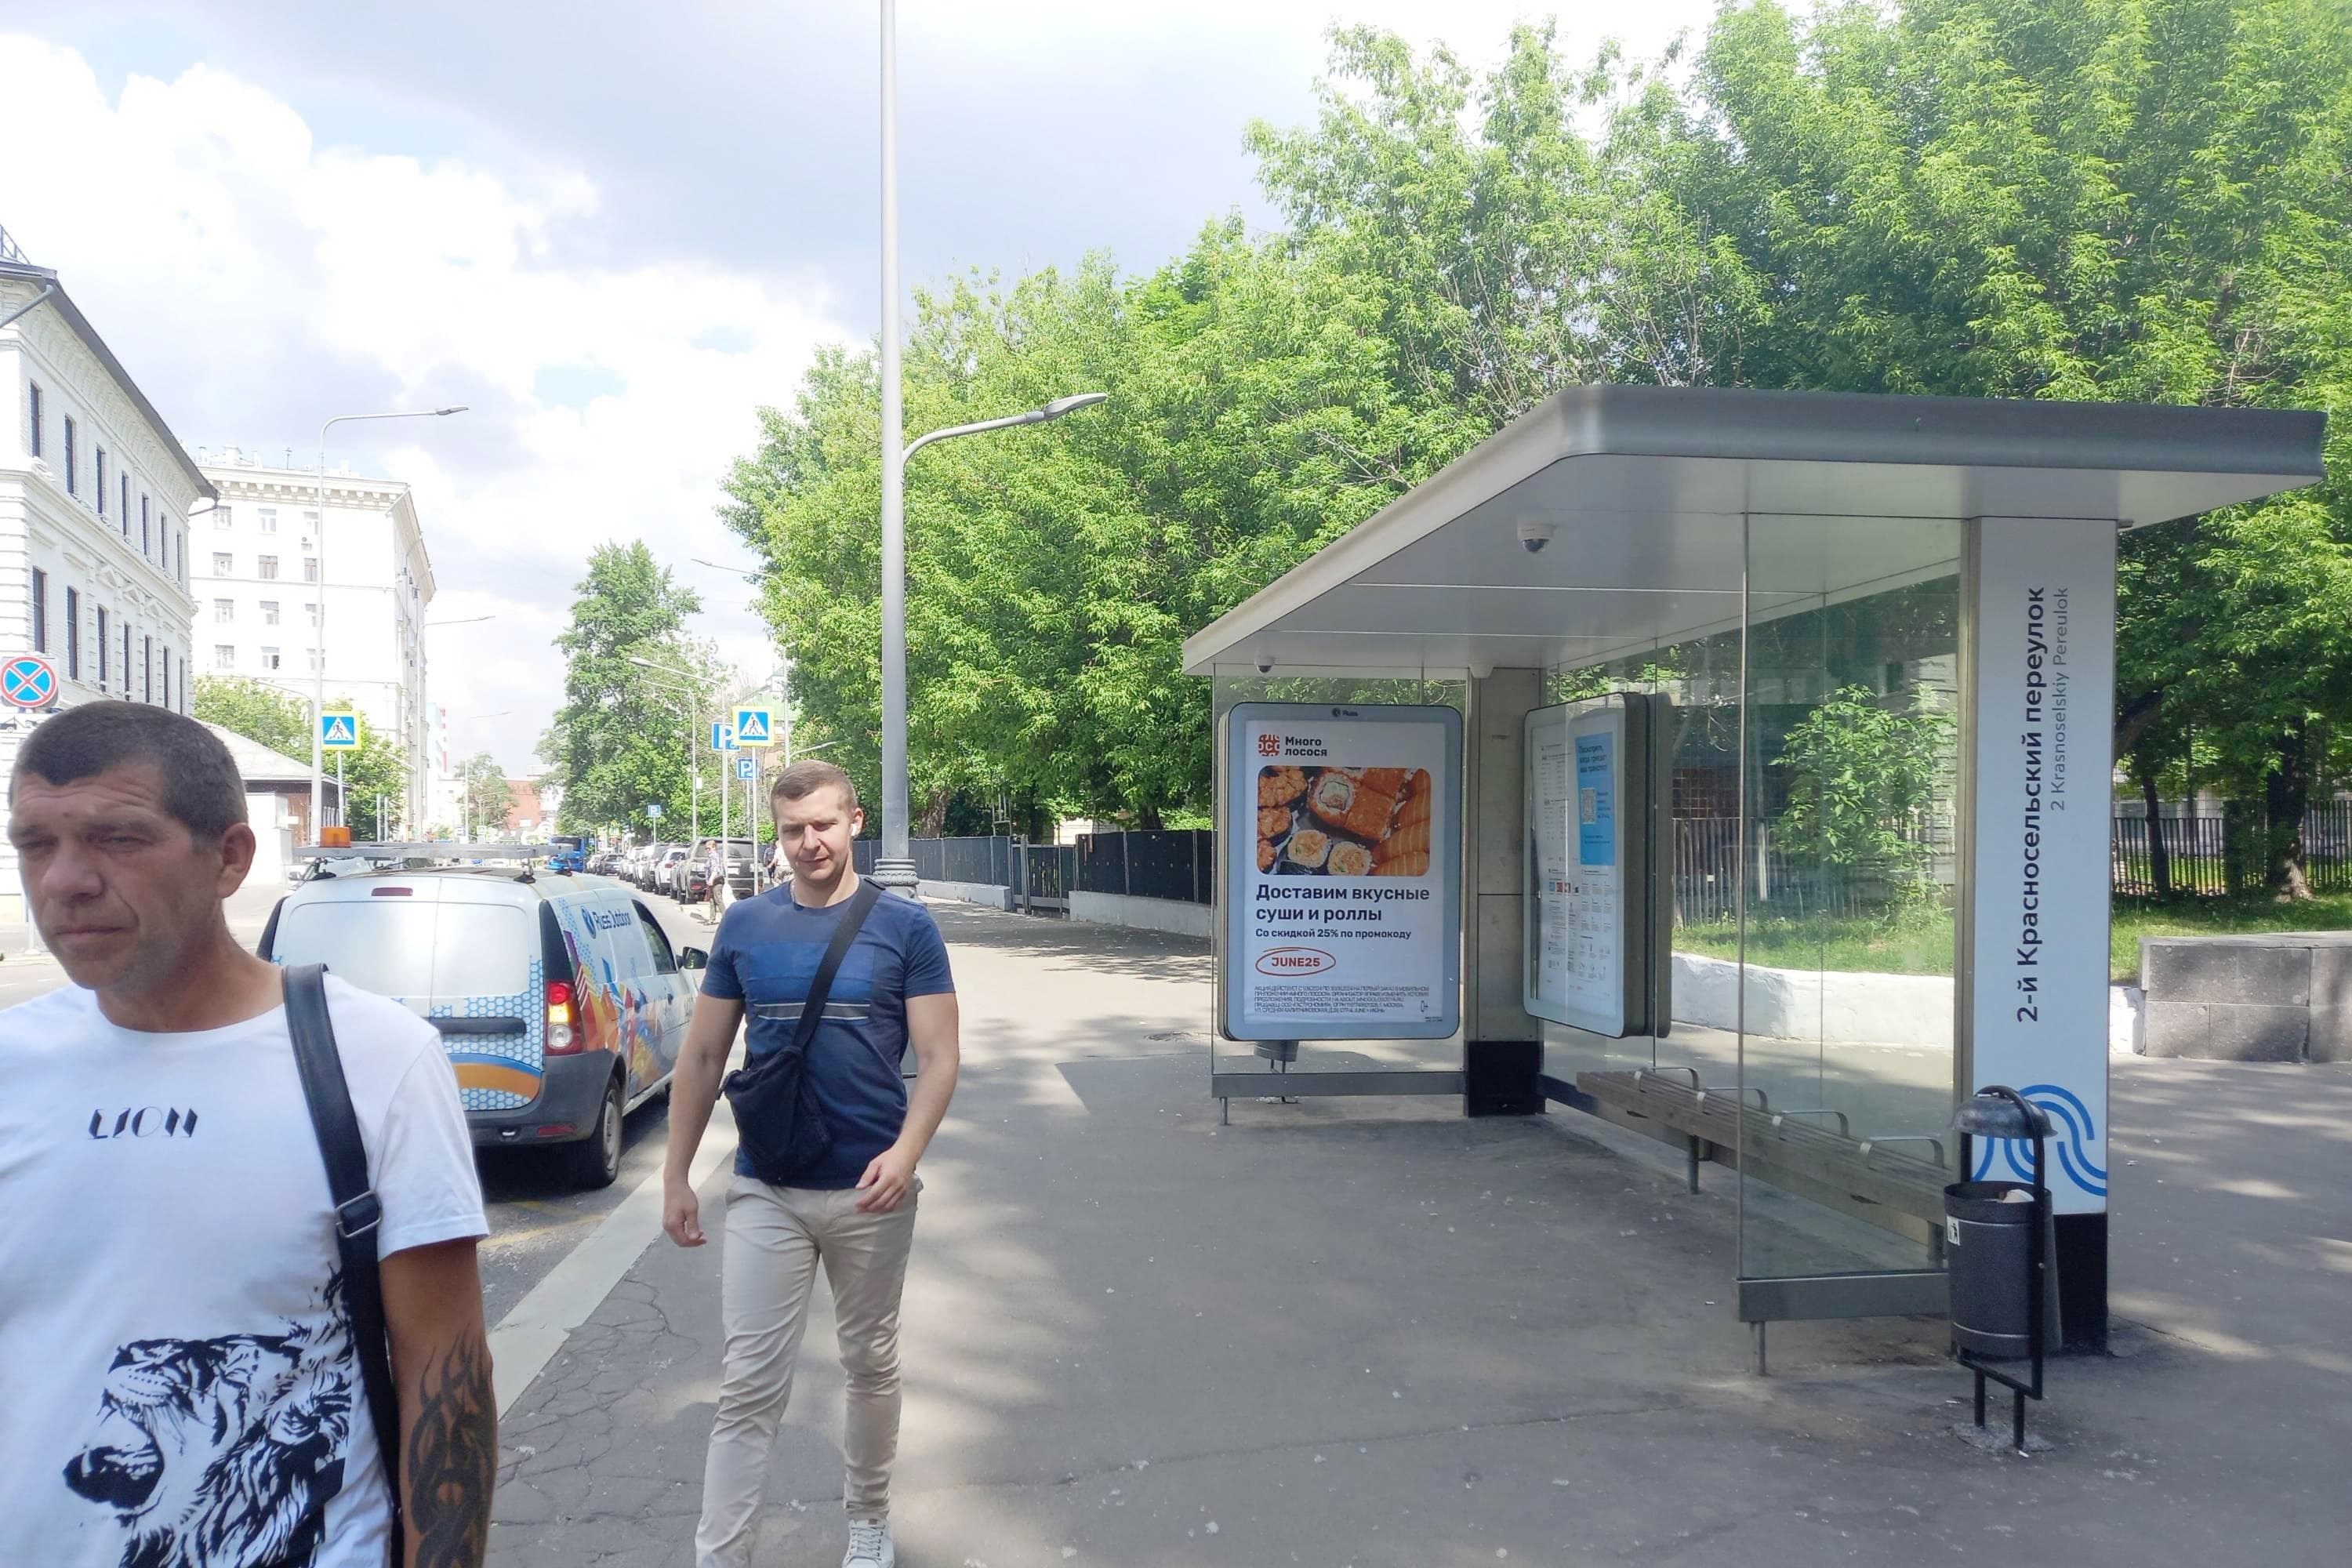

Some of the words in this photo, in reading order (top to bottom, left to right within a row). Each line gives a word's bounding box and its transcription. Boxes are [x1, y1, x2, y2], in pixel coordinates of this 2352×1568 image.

[2053, 588, 2068, 666] Pereulok
[2026, 587, 2048, 722] переулок
[1285, 736, 1322, 746] Много
[2050, 672, 2070, 793] Krasnoselskiy
[1285, 748, 1328, 757] лосося
[2050, 800, 2064, 811] 2
[2017, 732, 2043, 966] Красносельский
[1256, 884, 1348, 901] Доставим
[1352, 888, 1430, 902] вкусные
[1256, 909, 1304, 924] суши
[1308, 909, 1319, 920] и
[1323, 909, 1382, 924] роллы
[1255, 928, 1269, 938] Со
[1272, 927, 1316, 938] скидкой
[1317, 928, 1339, 938] 25%
[1355, 931, 1412, 940] промокоду
[1271, 956, 1321, 967] JUNE25
[2016, 977, 2038, 1022] 2-й
[88, 1106, 198, 1140] LION
